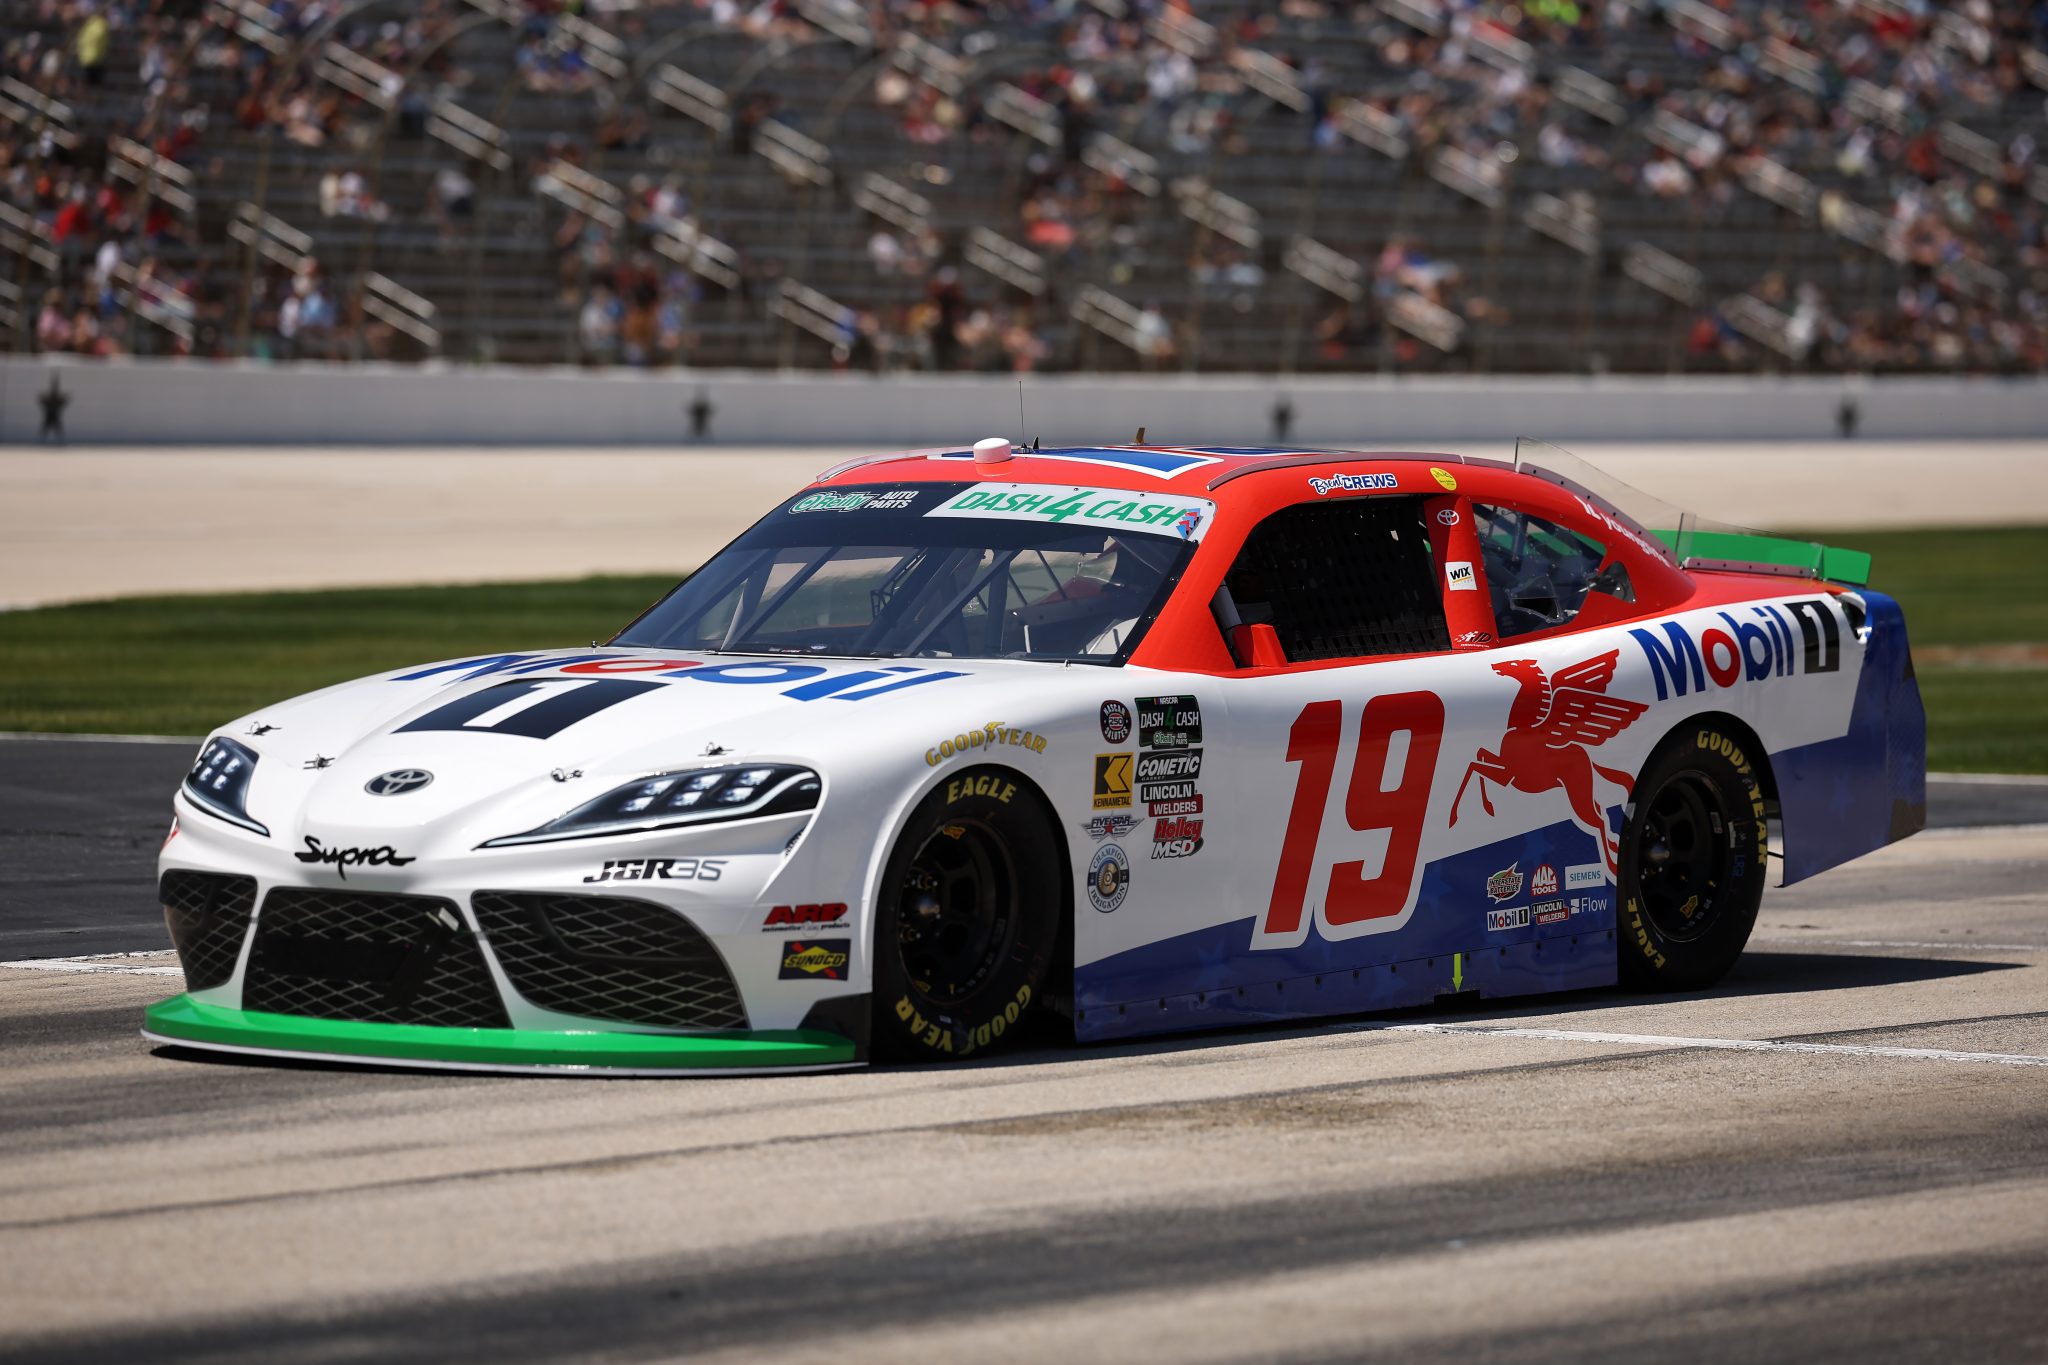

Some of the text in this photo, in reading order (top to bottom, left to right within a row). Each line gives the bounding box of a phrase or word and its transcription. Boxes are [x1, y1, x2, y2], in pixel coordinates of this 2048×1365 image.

[1309, 473, 1397, 493] Brent CREWS
[879, 491, 920, 500] AUTO
[863, 500, 913, 510] PARTS
[949, 490, 1188, 527] DASH 4 CASH
[1450, 566, 1471, 580] WIX
[1627, 605, 1795, 702] Mobil
[388, 654, 974, 701] Mobil
[1159, 697, 1179, 705] NASCAR
[1103, 704, 1126, 716] NASCAR
[1109, 717, 1123, 725] 250
[1140, 712, 1165, 729] DASH
[1176, 711, 1200, 727] CASH
[1104, 726, 1128, 741] SALUTES
[1137, 756, 1200, 778] COMETIC
[946, 775, 1017, 805] EAGLE
[1143, 784, 1192, 801] LINCOLN
[1093, 796, 1132, 808] KENNAMETAL
[1153, 801, 1198, 815] WELDERS
[1264, 690, 1446, 932] 19
[1091, 815, 1131, 828] FIVE STAR
[1154, 817, 1204, 842] Holley
[294, 834, 417, 882] Supra
[1093, 847, 1126, 869] CHAMPION
[1151, 840, 1197, 860] MSD
[1488, 876, 1522, 887] INTERSTATE
[1532, 865, 1557, 887] MAC
[1569, 870, 1601, 882] SIEMENS
[1090, 884, 1126, 910] IRRIGATION
[1489, 884, 1520, 895] BATTERIES
[1531, 884, 1558, 896] TOOLS
[1533, 901, 1563, 915] LINCOLN
[1581, 897, 1607, 912] Flow
[763, 903, 848, 925] ARP
[1488, 909, 1517, 929] Mobil
[1539, 911, 1566, 923] WELDERS
[1627, 896, 1667, 970] EAGLE
[787, 953, 844, 967] SUNOCO
